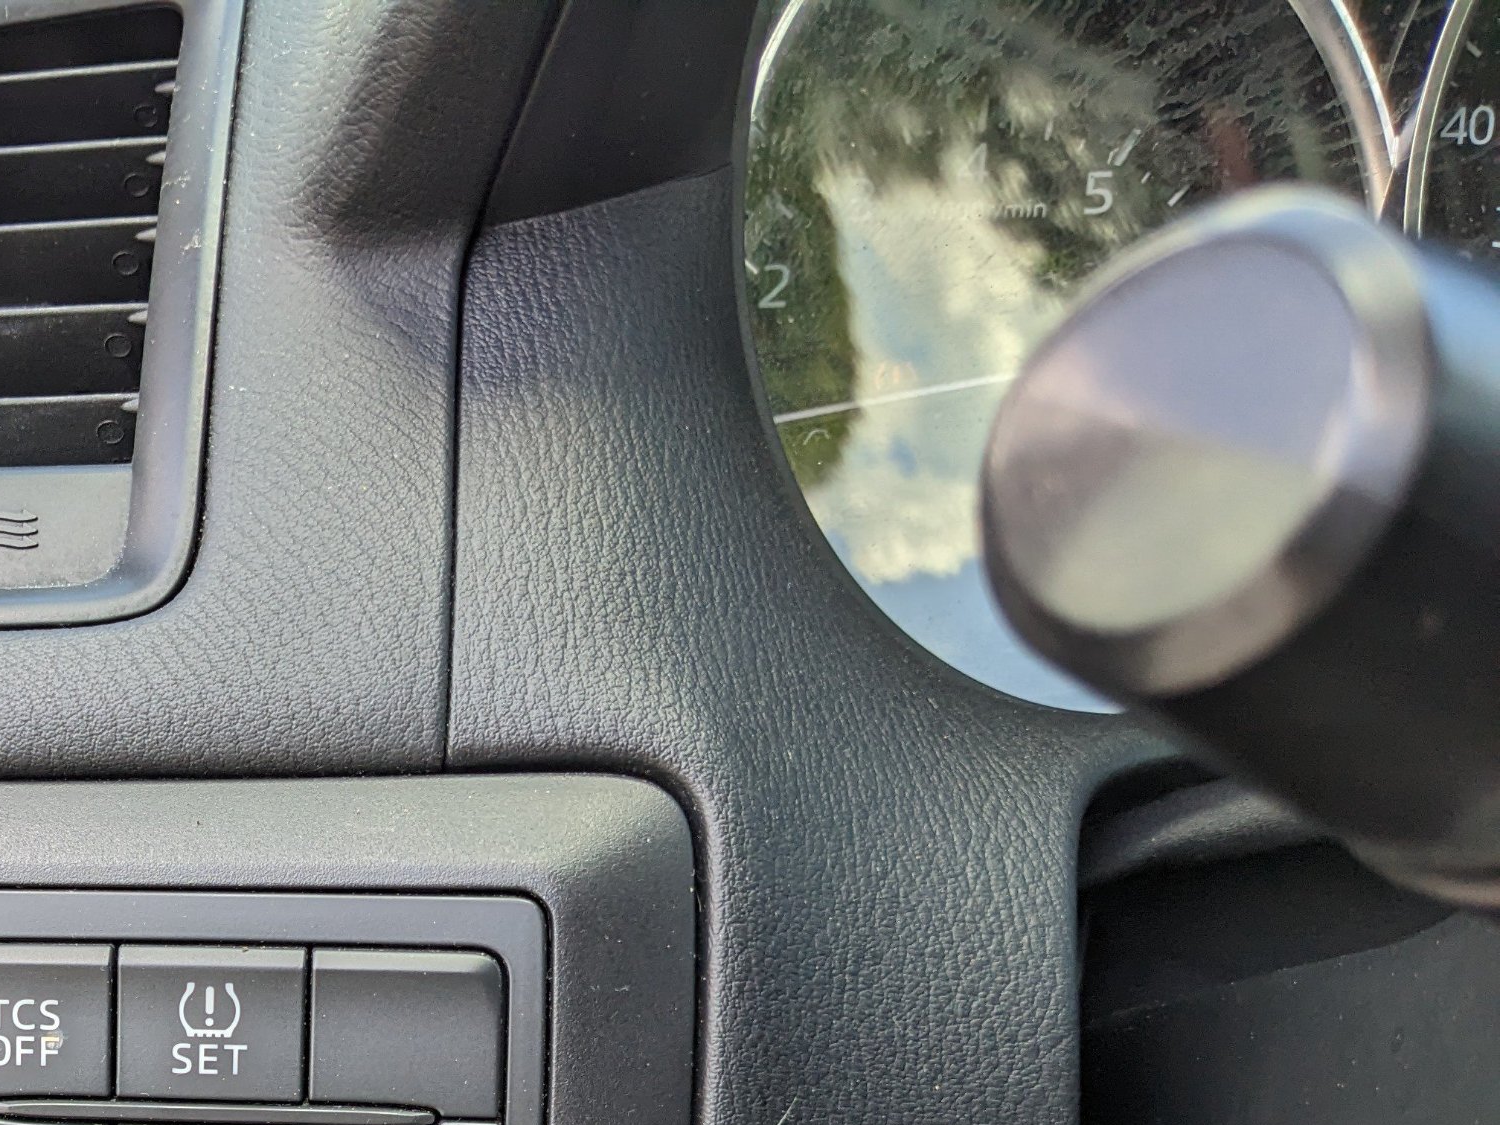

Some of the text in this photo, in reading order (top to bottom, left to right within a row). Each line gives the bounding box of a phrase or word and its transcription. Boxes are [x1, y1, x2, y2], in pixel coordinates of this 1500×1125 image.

[1440, 104, 1496, 146] 40
[1083, 170, 1114, 215] 5
[758, 263, 790, 309] 2
[171, 1042, 248, 1075] SET
